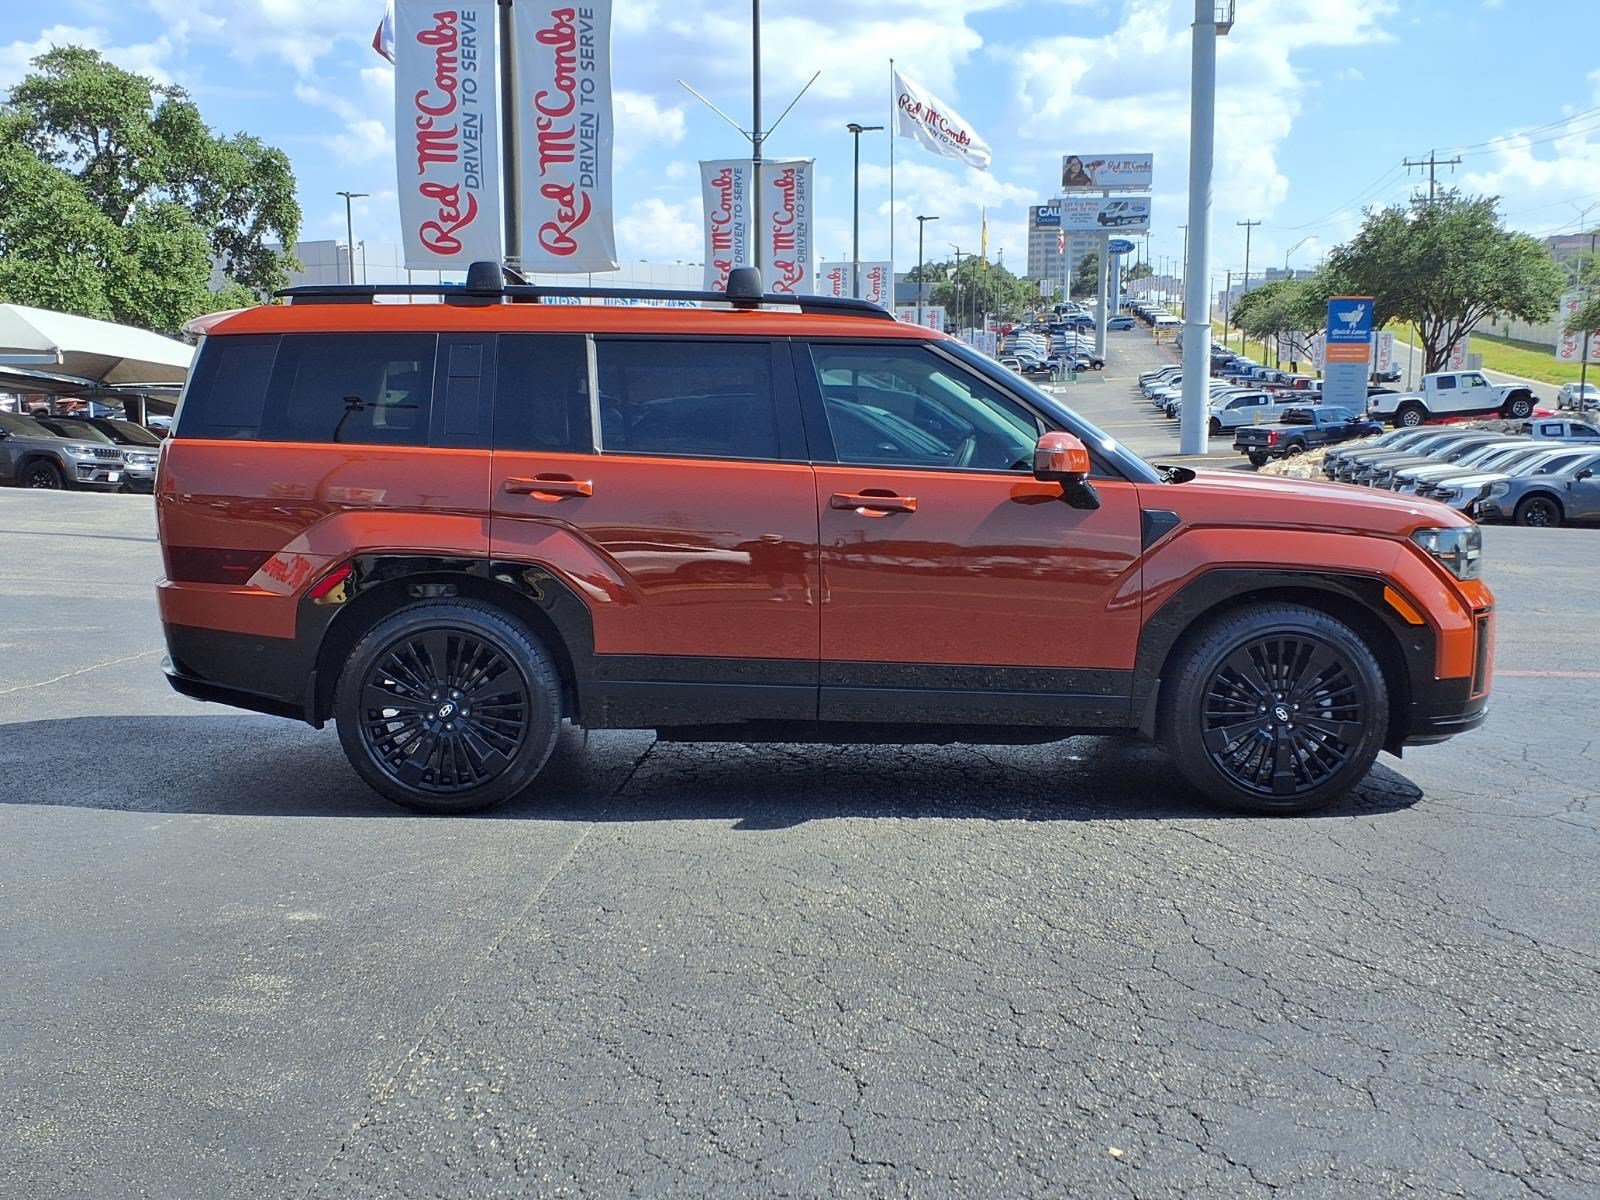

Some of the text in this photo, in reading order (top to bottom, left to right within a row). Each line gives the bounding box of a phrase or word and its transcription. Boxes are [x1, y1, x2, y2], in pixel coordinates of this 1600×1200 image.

[415, 10, 459, 176] McCombs
[462, 10, 481, 190] DRIVEN TO SERVE
[534, 7, 577, 177] McCombs
[579, 7, 597, 190] DRIVEN TO SERVE
[898, 93, 971, 145] Red McCombs
[939, 134, 949, 143] TO
[949, 140, 968, 154] SERVE
[1107, 160, 1121, 173] Red
[418, 182, 478, 255] Red
[538, 182, 592, 256] Red
[711, 167, 732, 256] McCombs
[734, 167, 744, 264] DRIVEN TO SERVE
[771, 168, 804, 294] Red McCombs
[796, 167, 806, 264] DRIVEN TO SERVE
[827, 267, 841, 297] ombs
[881, 290, 887, 299] TO
[1331, 328, 1351, 336] Quick
[1561, 341, 1577, 358] Red
